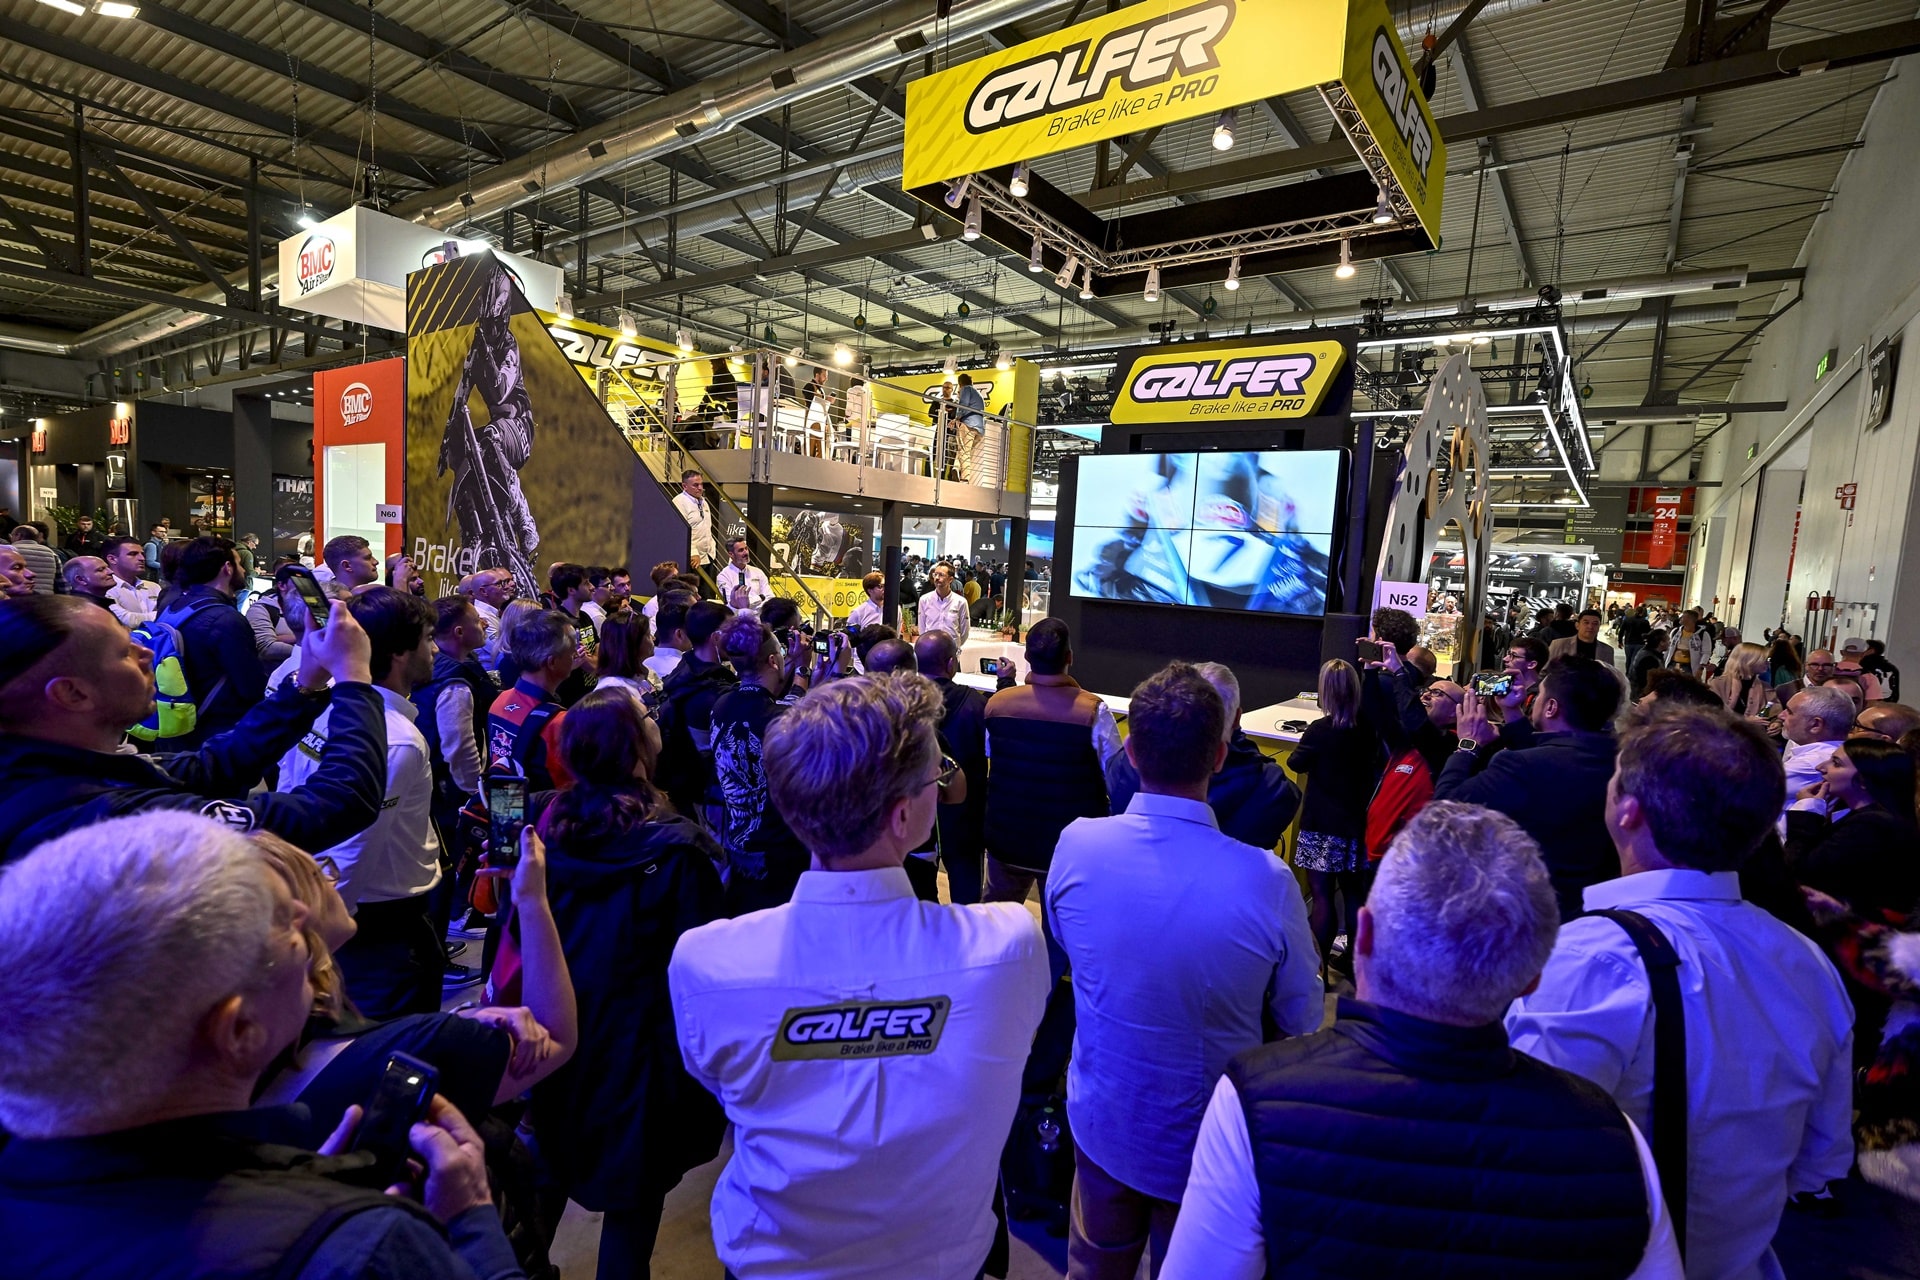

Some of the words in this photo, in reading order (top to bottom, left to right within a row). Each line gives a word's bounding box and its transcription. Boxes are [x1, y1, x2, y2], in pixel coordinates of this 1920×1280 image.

[966, 2, 1233, 131] GALFER
[1047, 104, 1106, 137] Brake
[1108, 97, 1144, 122] like
[1147, 93, 1162, 111] a
[1165, 74, 1219, 106] PRO
[1372, 31, 1432, 182] GALFER
[301, 243, 331, 280] BMC
[301, 278, 315, 296] Air
[1132, 356, 1315, 401] GALFER
[343, 393, 370, 415] BMC
[1189, 403, 1230, 415] Brake
[1231, 400, 1256, 413] like
[1258, 402, 1266, 412] a
[1270, 398, 1305, 411] PRO
[380, 510, 397, 519] N60
[1655, 507, 1677, 520] 24
[726, 523, 746, 537] like
[413, 537, 473, 576] Brake
[1389, 593, 1418, 607] N52
[786, 1005, 933, 1043] GALFER
[840, 1042, 873, 1056] Brake
[875, 1040, 896, 1053] like
[898, 1041, 905, 1050] a
[906, 1038, 932, 1050] PRO
